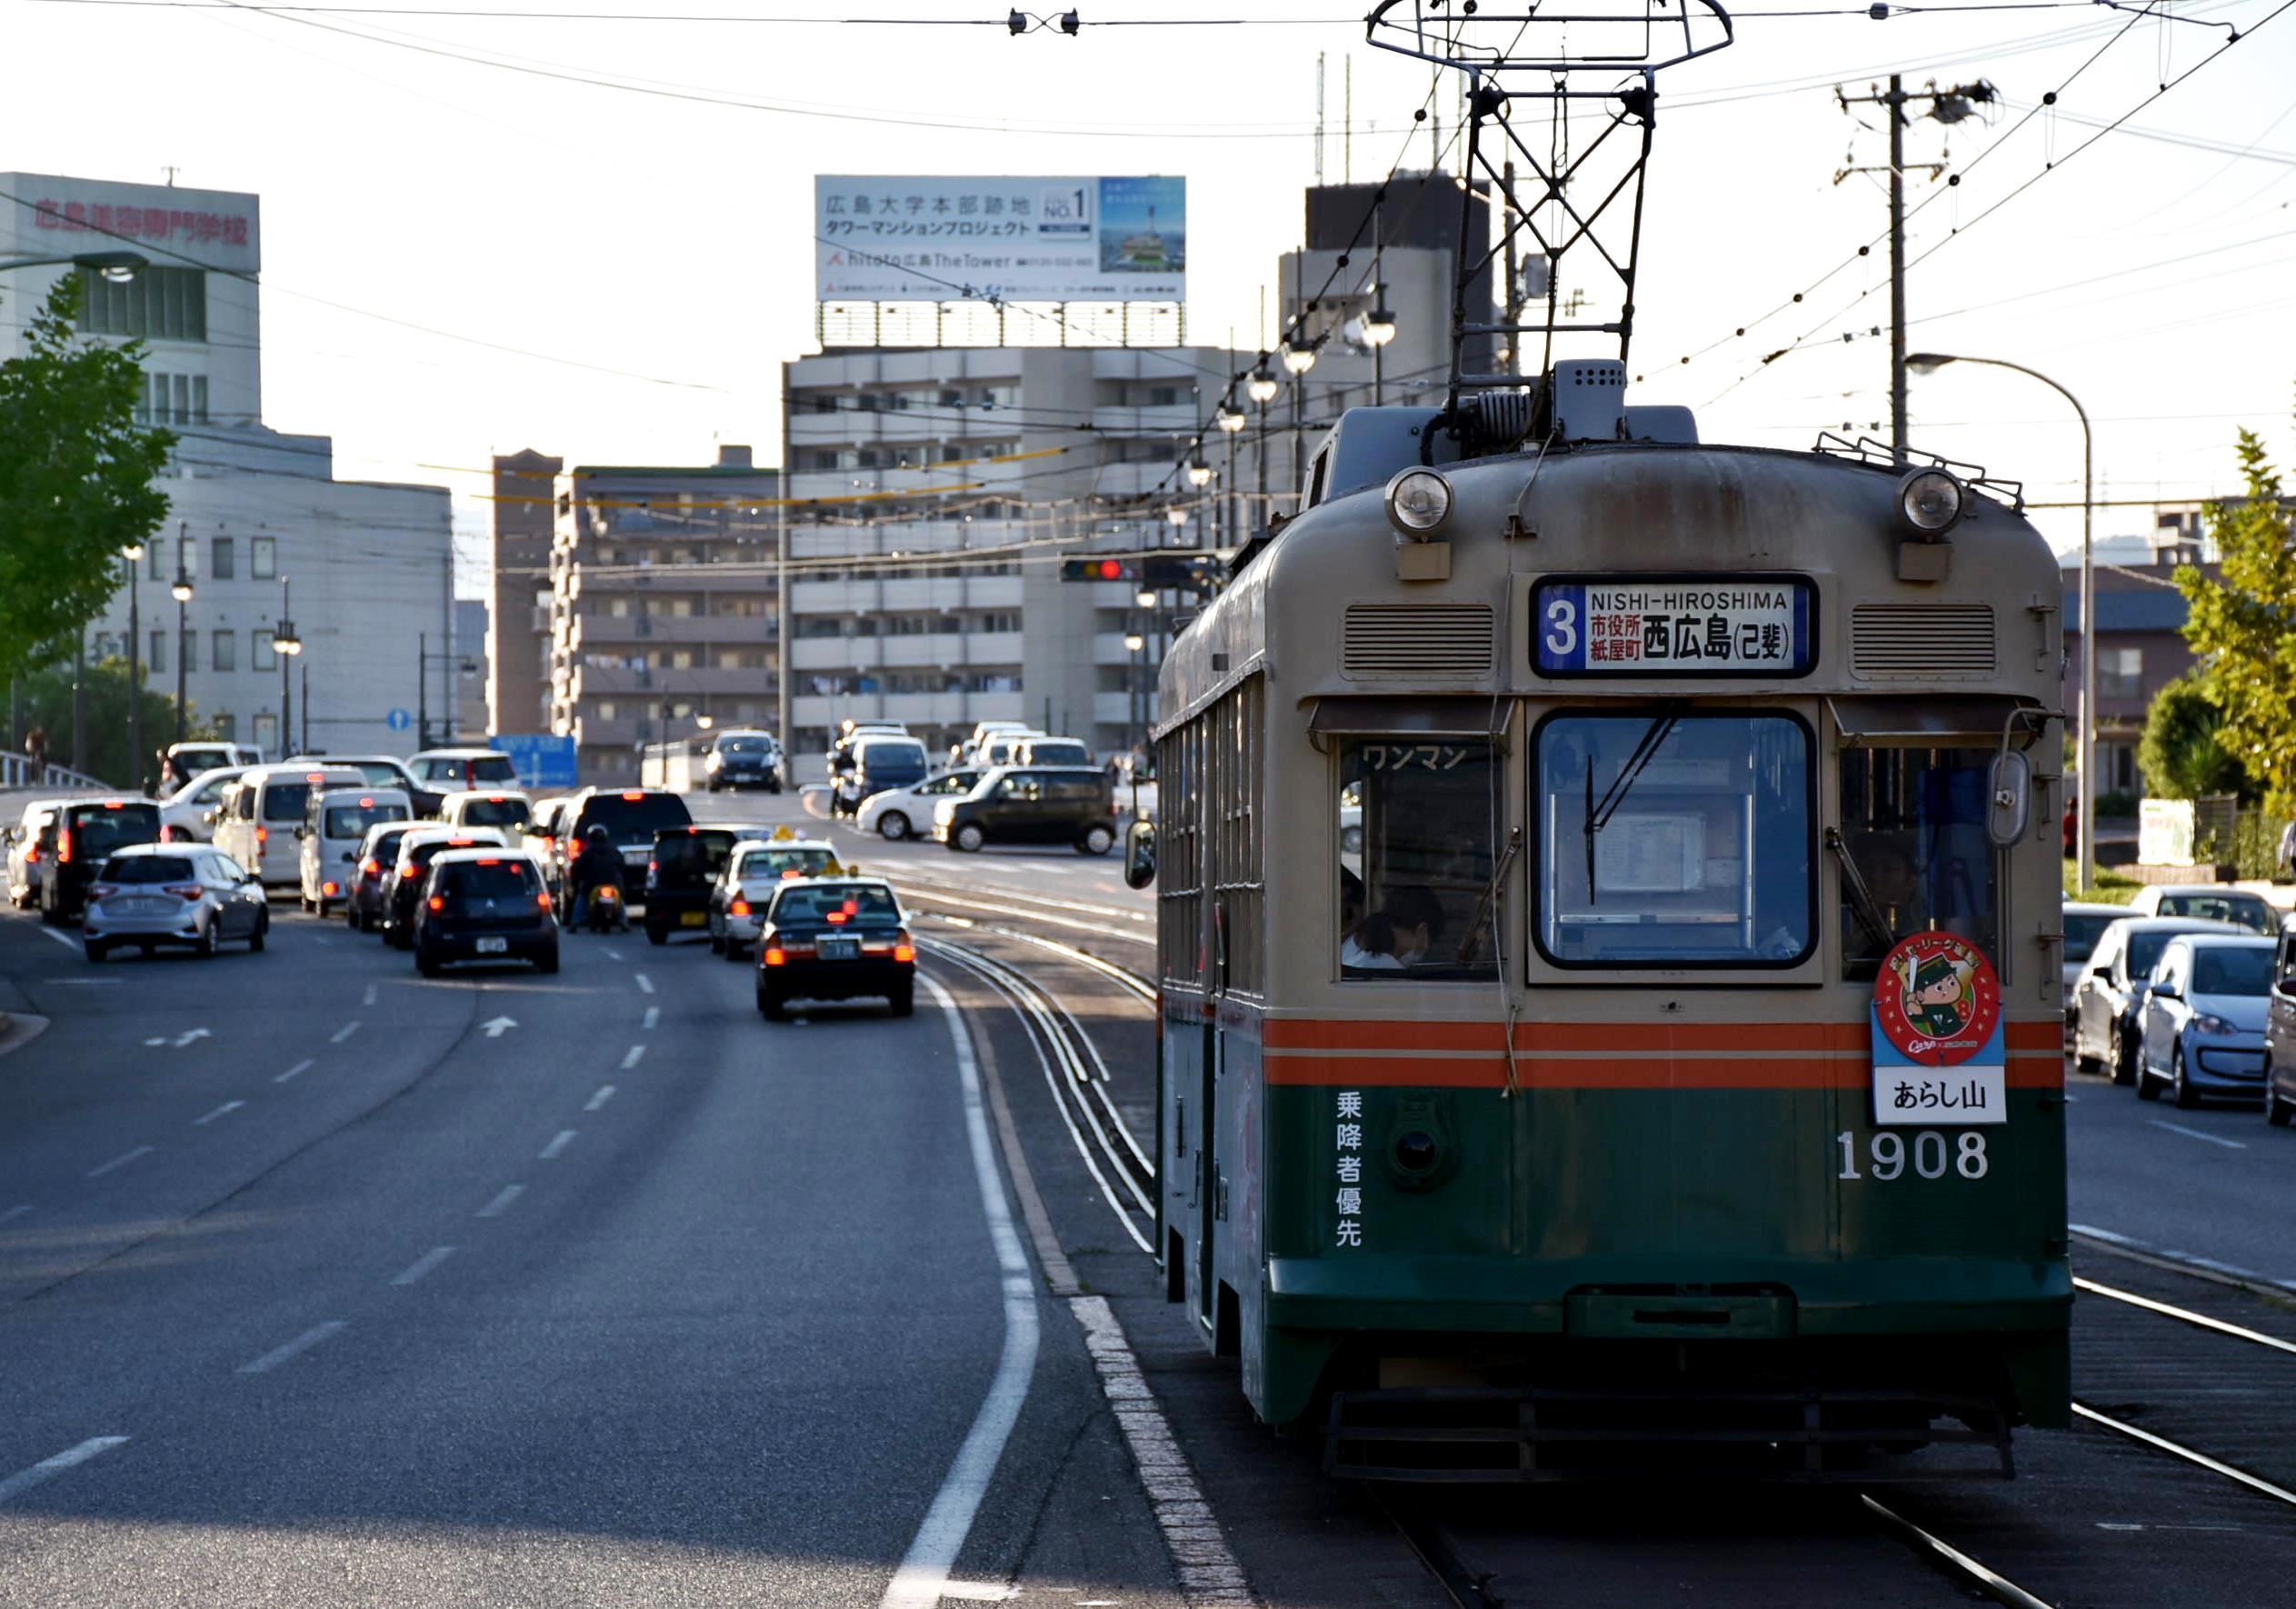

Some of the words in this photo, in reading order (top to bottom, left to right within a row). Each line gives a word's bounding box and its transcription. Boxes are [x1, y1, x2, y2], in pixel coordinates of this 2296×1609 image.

[825, 195, 1032, 216] 広島大学本部跡地
[825, 221, 1031, 236] タワーマンションプロジェクト
[1591, 592, 1788, 610] NISHI-HIROSHIMA
[1546, 599, 1577, 655] 3
[1591, 614, 1642, 636] 市役所
[1591, 639, 1642, 662] 紙屋町
[1363, 745, 1468, 770] ワンマン
[1893, 1079, 1987, 1110] あらし山
[1836, 1130, 1989, 1181] 1908
[1335, 1091, 1363, 1248] 乗降者優先
